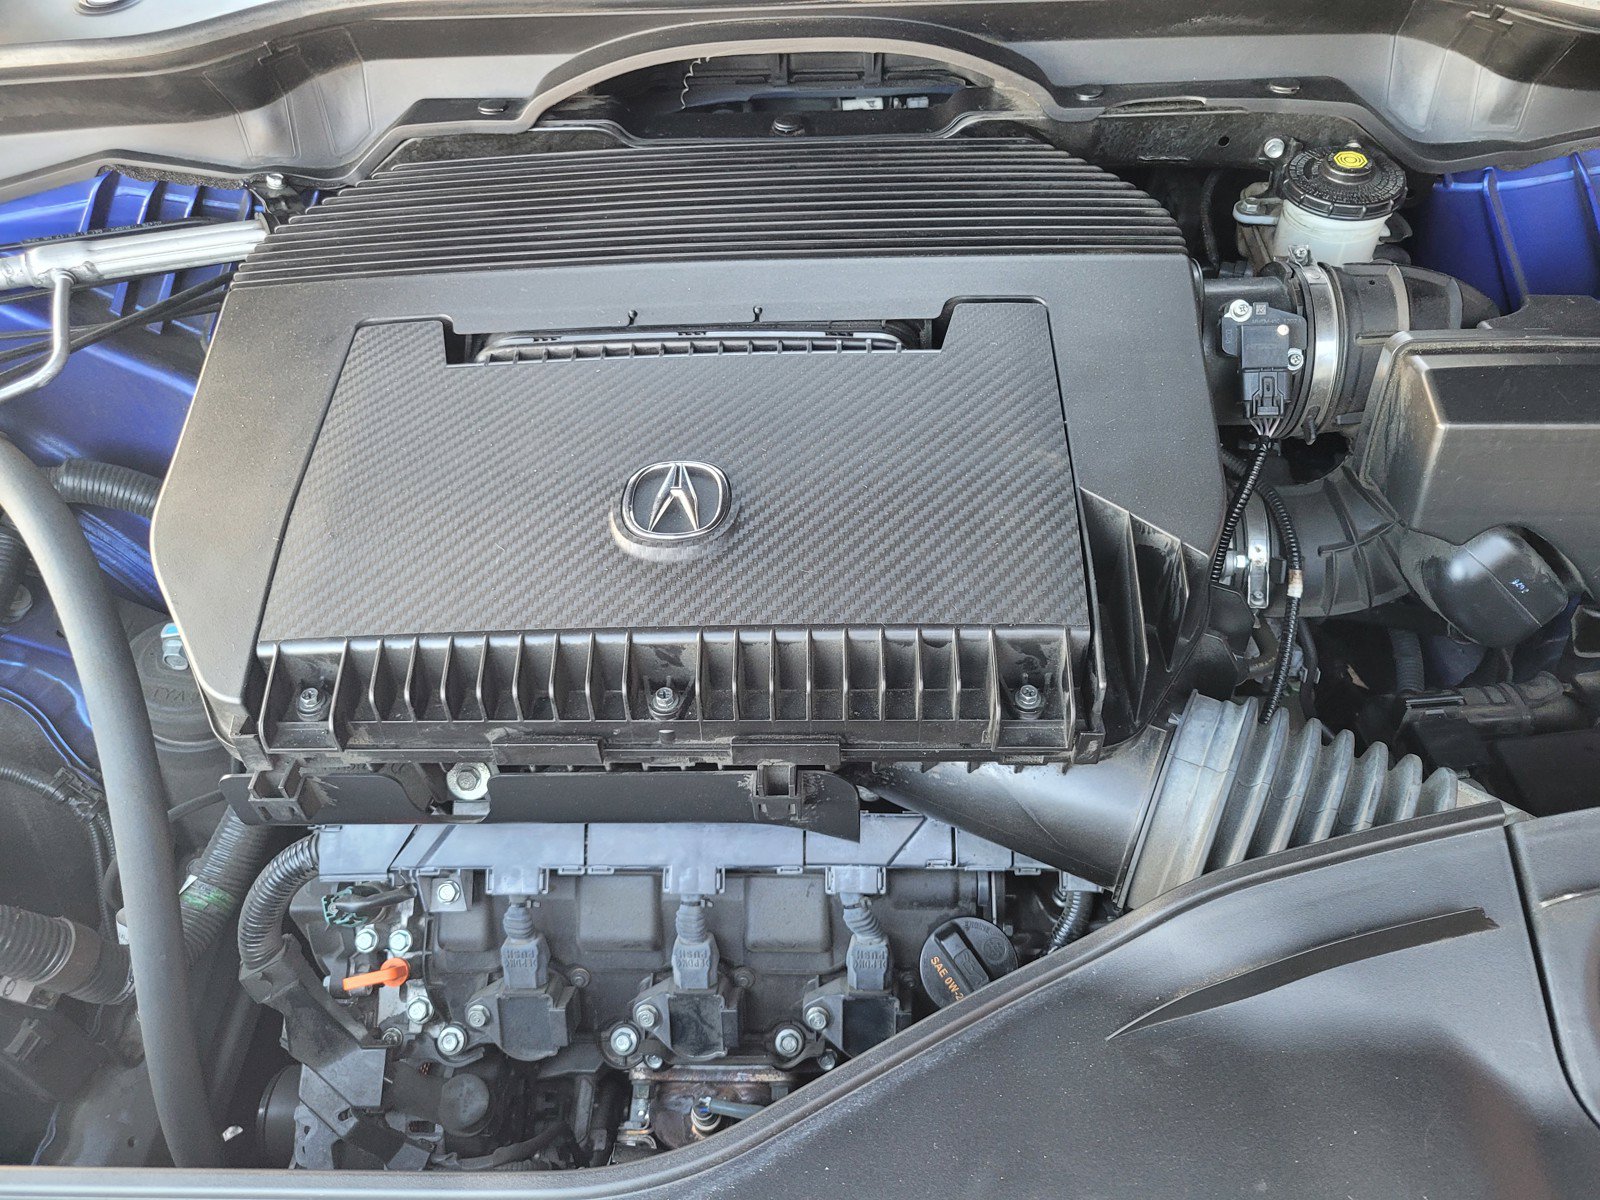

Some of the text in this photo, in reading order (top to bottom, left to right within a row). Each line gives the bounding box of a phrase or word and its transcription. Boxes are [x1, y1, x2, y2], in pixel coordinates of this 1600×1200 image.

[507, 949, 535, 959] PUSH
[679, 949, 708, 959] PUSH
[856, 950, 885, 960] PUSH
[930, 956, 965, 1001] SAE 0W-2
